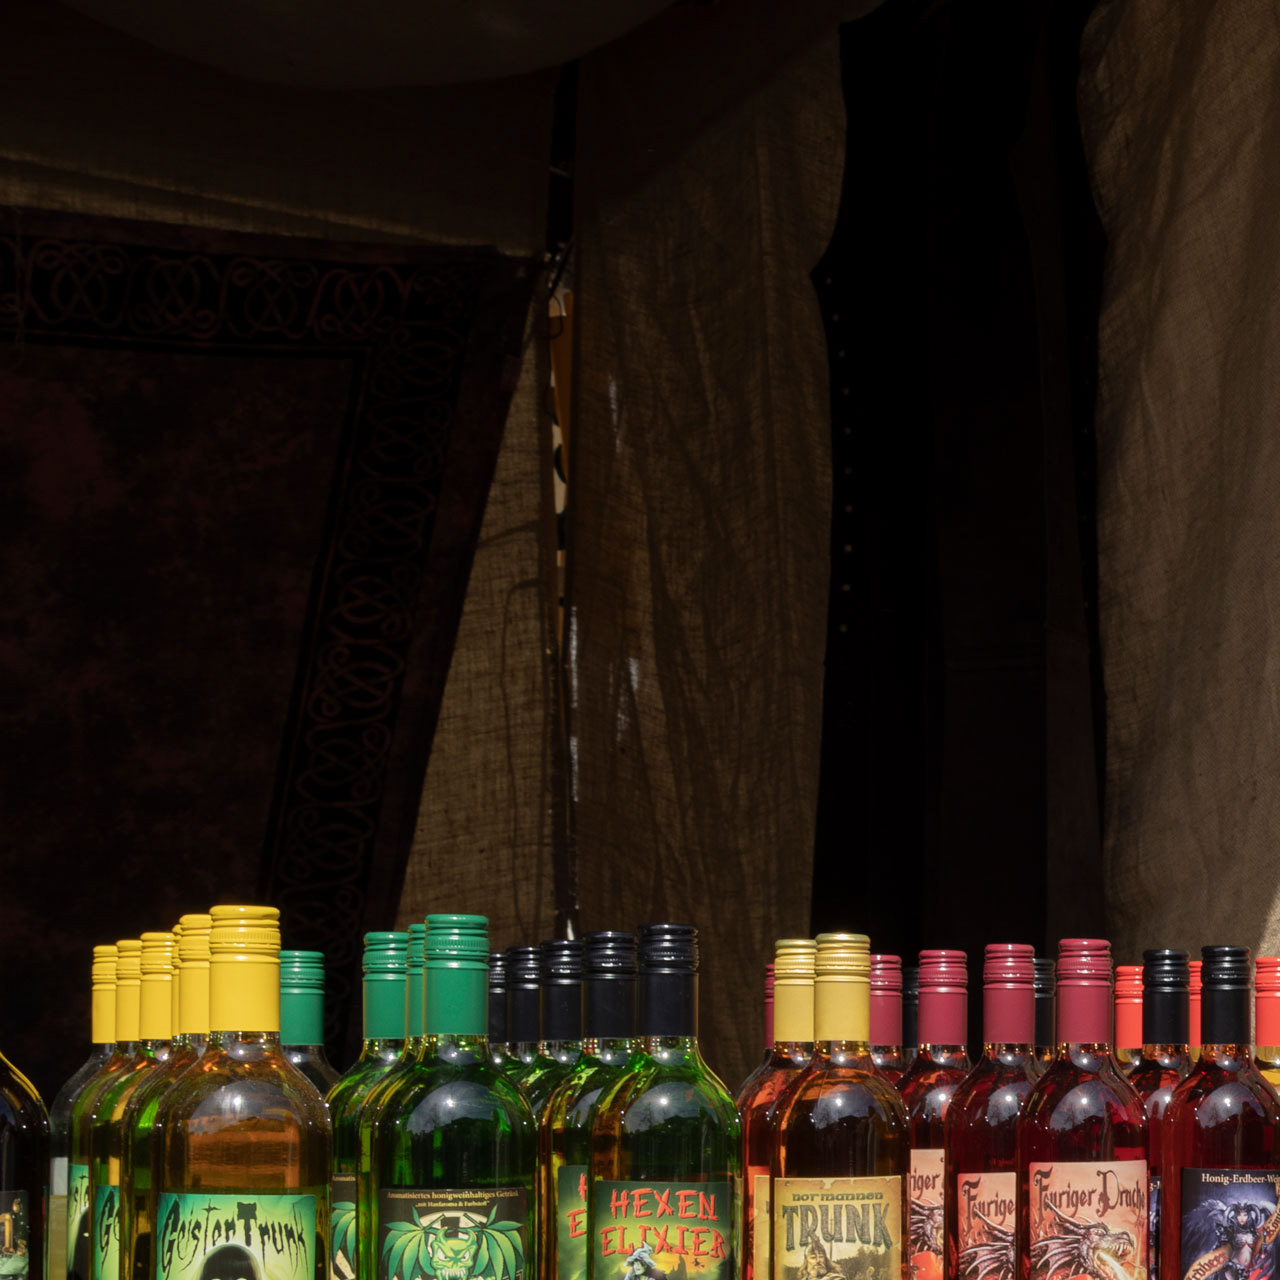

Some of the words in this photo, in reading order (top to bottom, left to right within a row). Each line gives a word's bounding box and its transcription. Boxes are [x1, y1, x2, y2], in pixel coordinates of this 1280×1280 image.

[610, 1187, 719, 1222] HEXEN
[961, 1176, 1015, 1236] Feurige
[600, 1225, 726, 1260] ELIXIER
[782, 1202, 893, 1252] TRUNK
